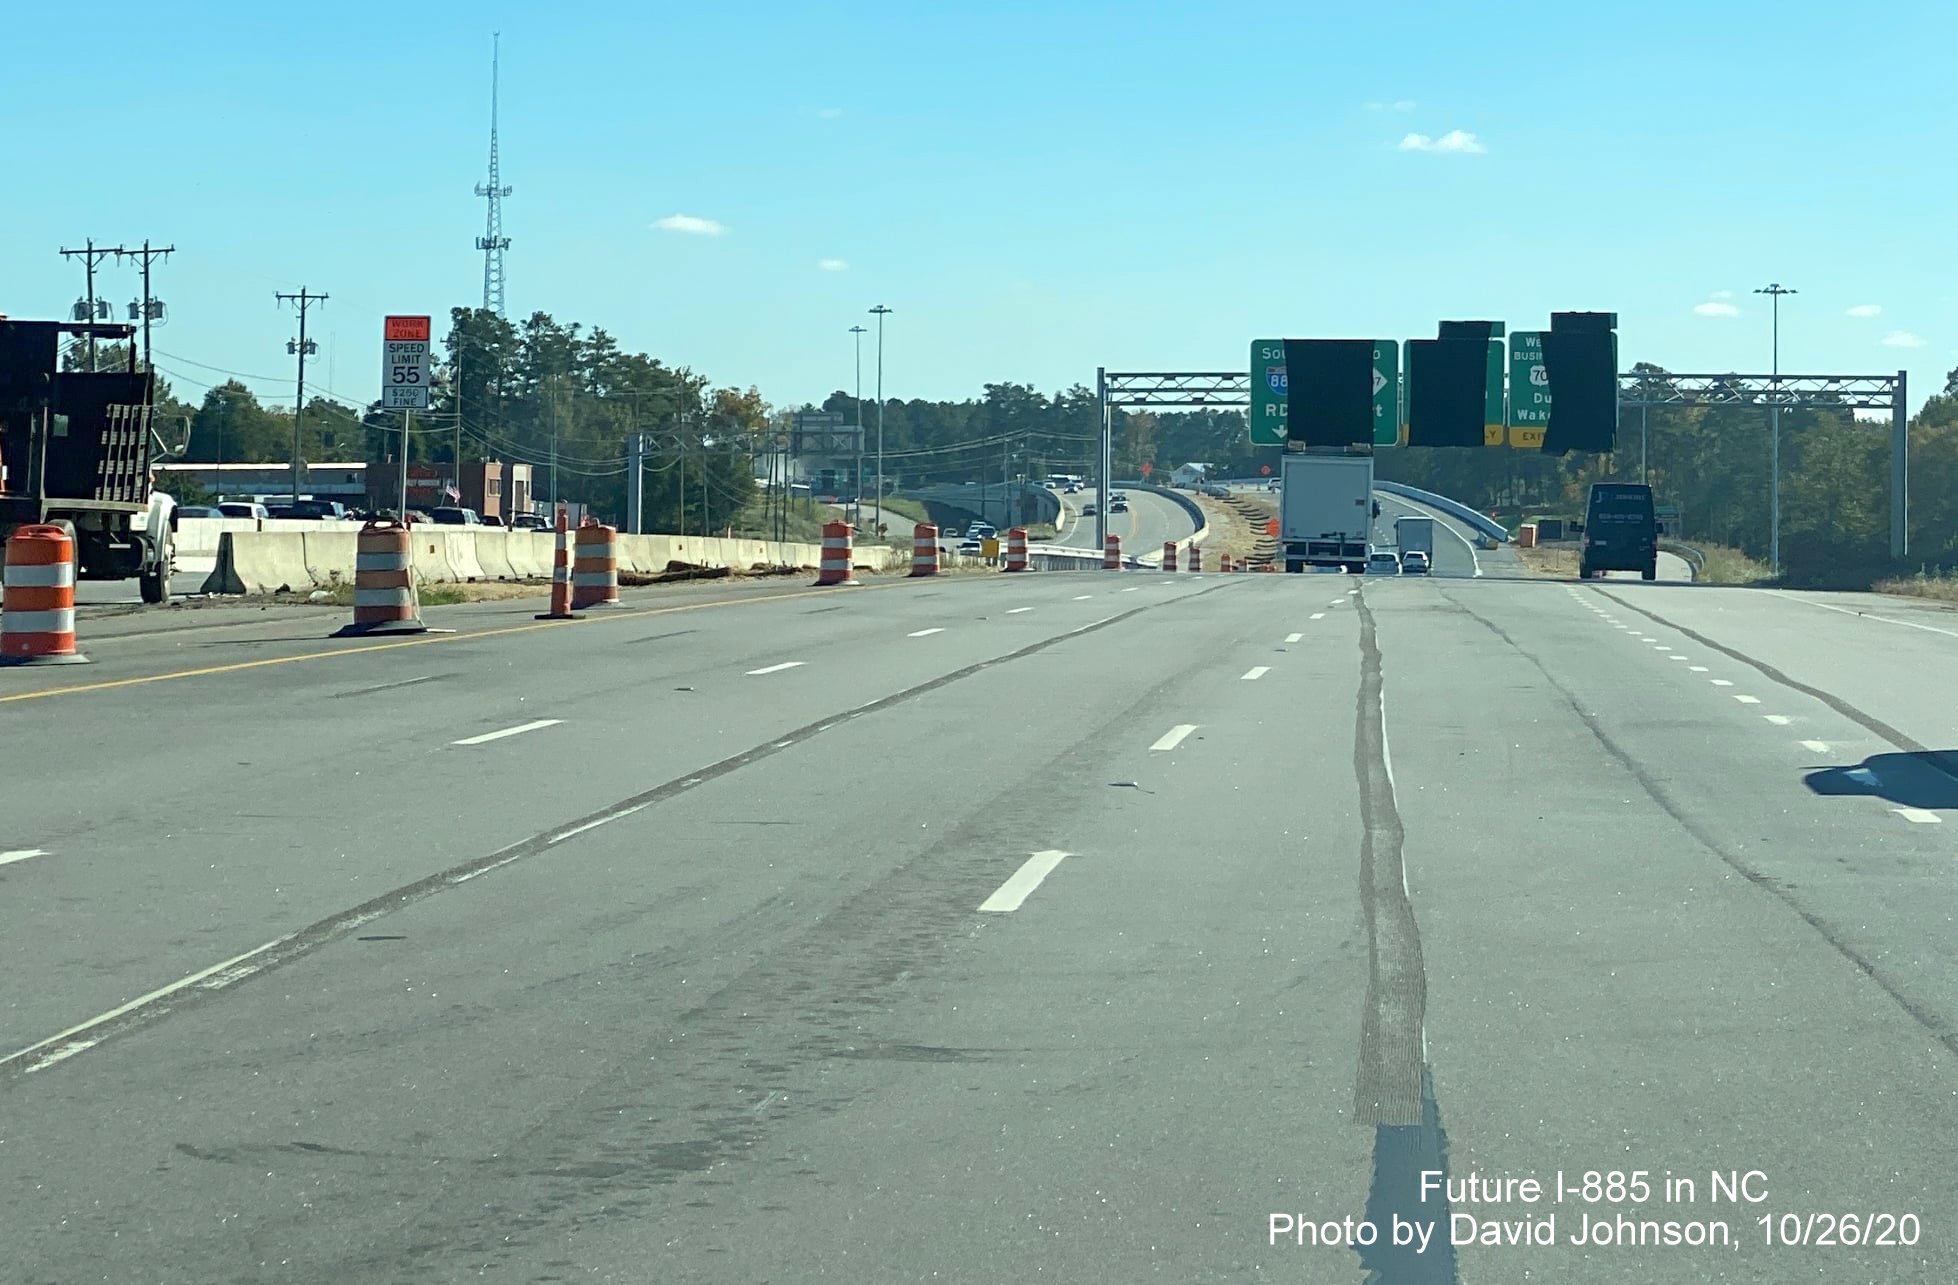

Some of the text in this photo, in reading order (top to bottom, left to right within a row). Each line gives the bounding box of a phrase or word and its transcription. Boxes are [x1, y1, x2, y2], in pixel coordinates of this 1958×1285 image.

[391, 319, 424, 328] WORK
[392, 329, 422, 338] ZONE
[388, 343, 425, 353] SPEED
[391, 354, 421, 364] LIMIT
[392, 366, 420, 384] 55
[1271, 374, 1289, 387] 88
[393, 397, 417, 406] FINE
[1533, 392, 1552, 403] Du
[1265, 403, 1289, 417] RD
[1517, 409, 1551, 420] Wak
